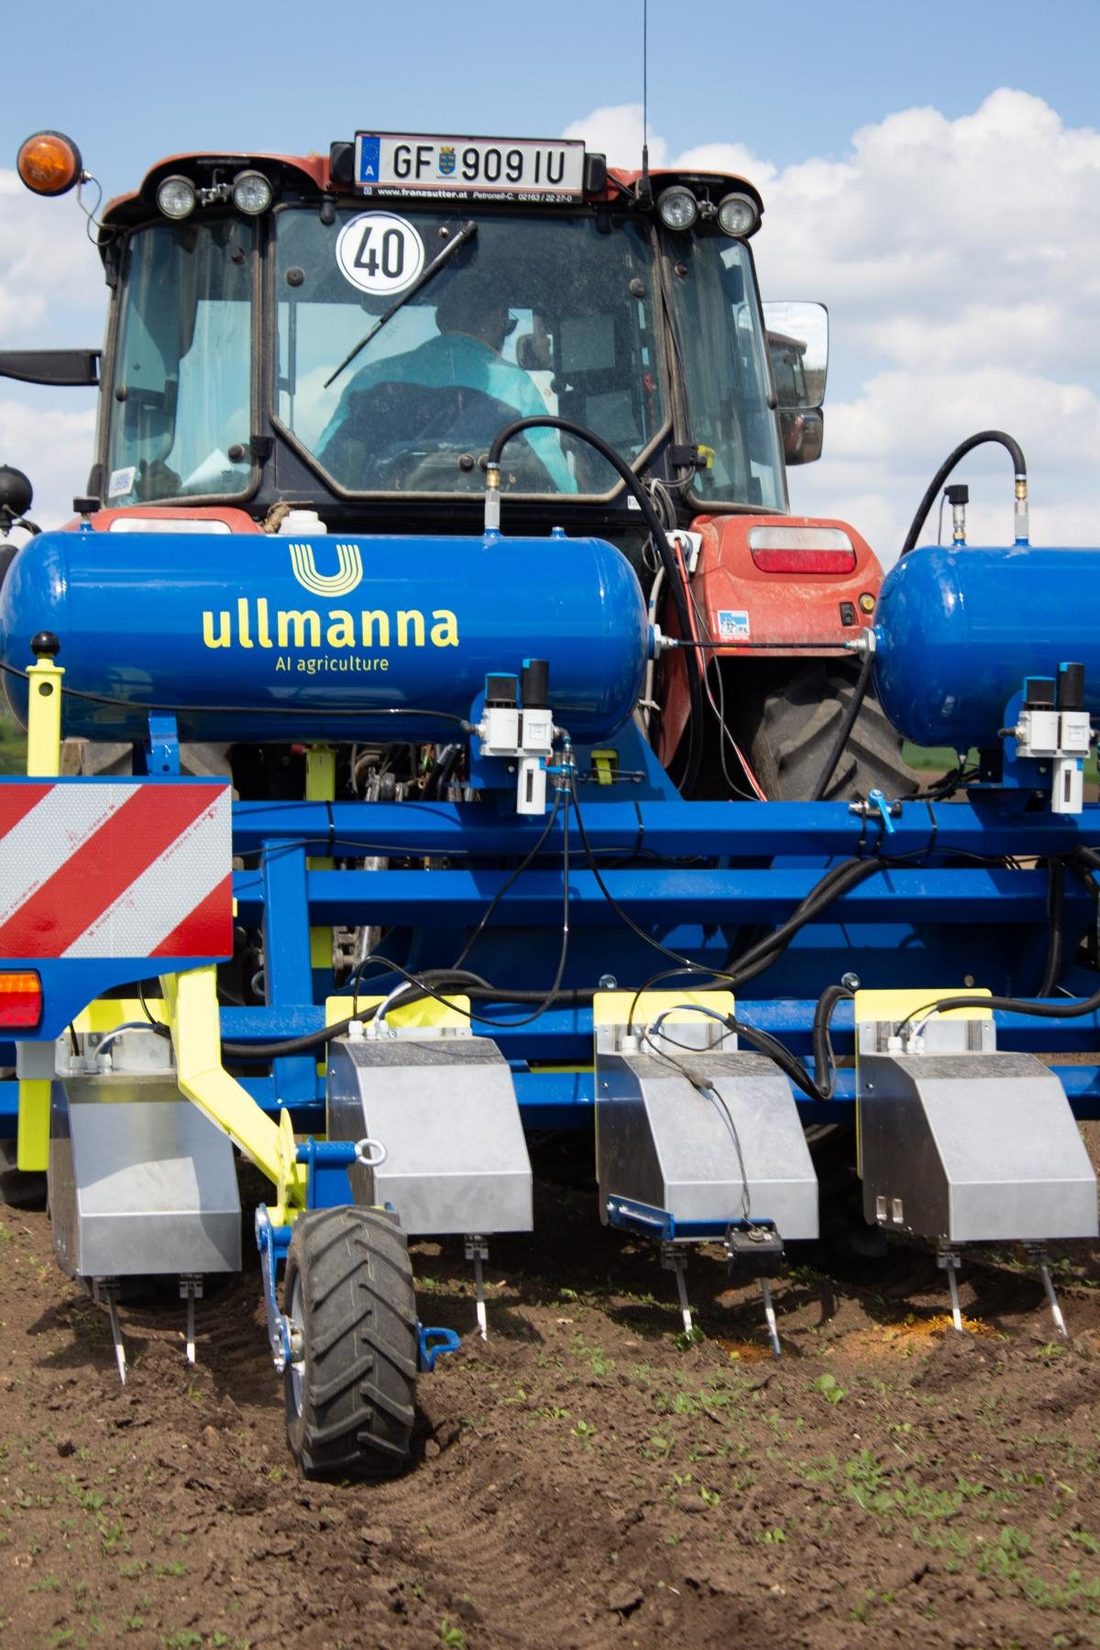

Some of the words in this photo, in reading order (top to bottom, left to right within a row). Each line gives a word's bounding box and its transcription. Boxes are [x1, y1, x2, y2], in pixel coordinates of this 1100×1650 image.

[364, 165, 375, 177] A
[393, 145, 434, 179] GF
[462, 147, 523, 182] 909
[535, 151, 565, 184] IU
[353, 227, 405, 278] 40
[202, 597, 460, 648] ullmanna
[275, 657, 292, 671] AI
[296, 655, 390, 675] agriculture
